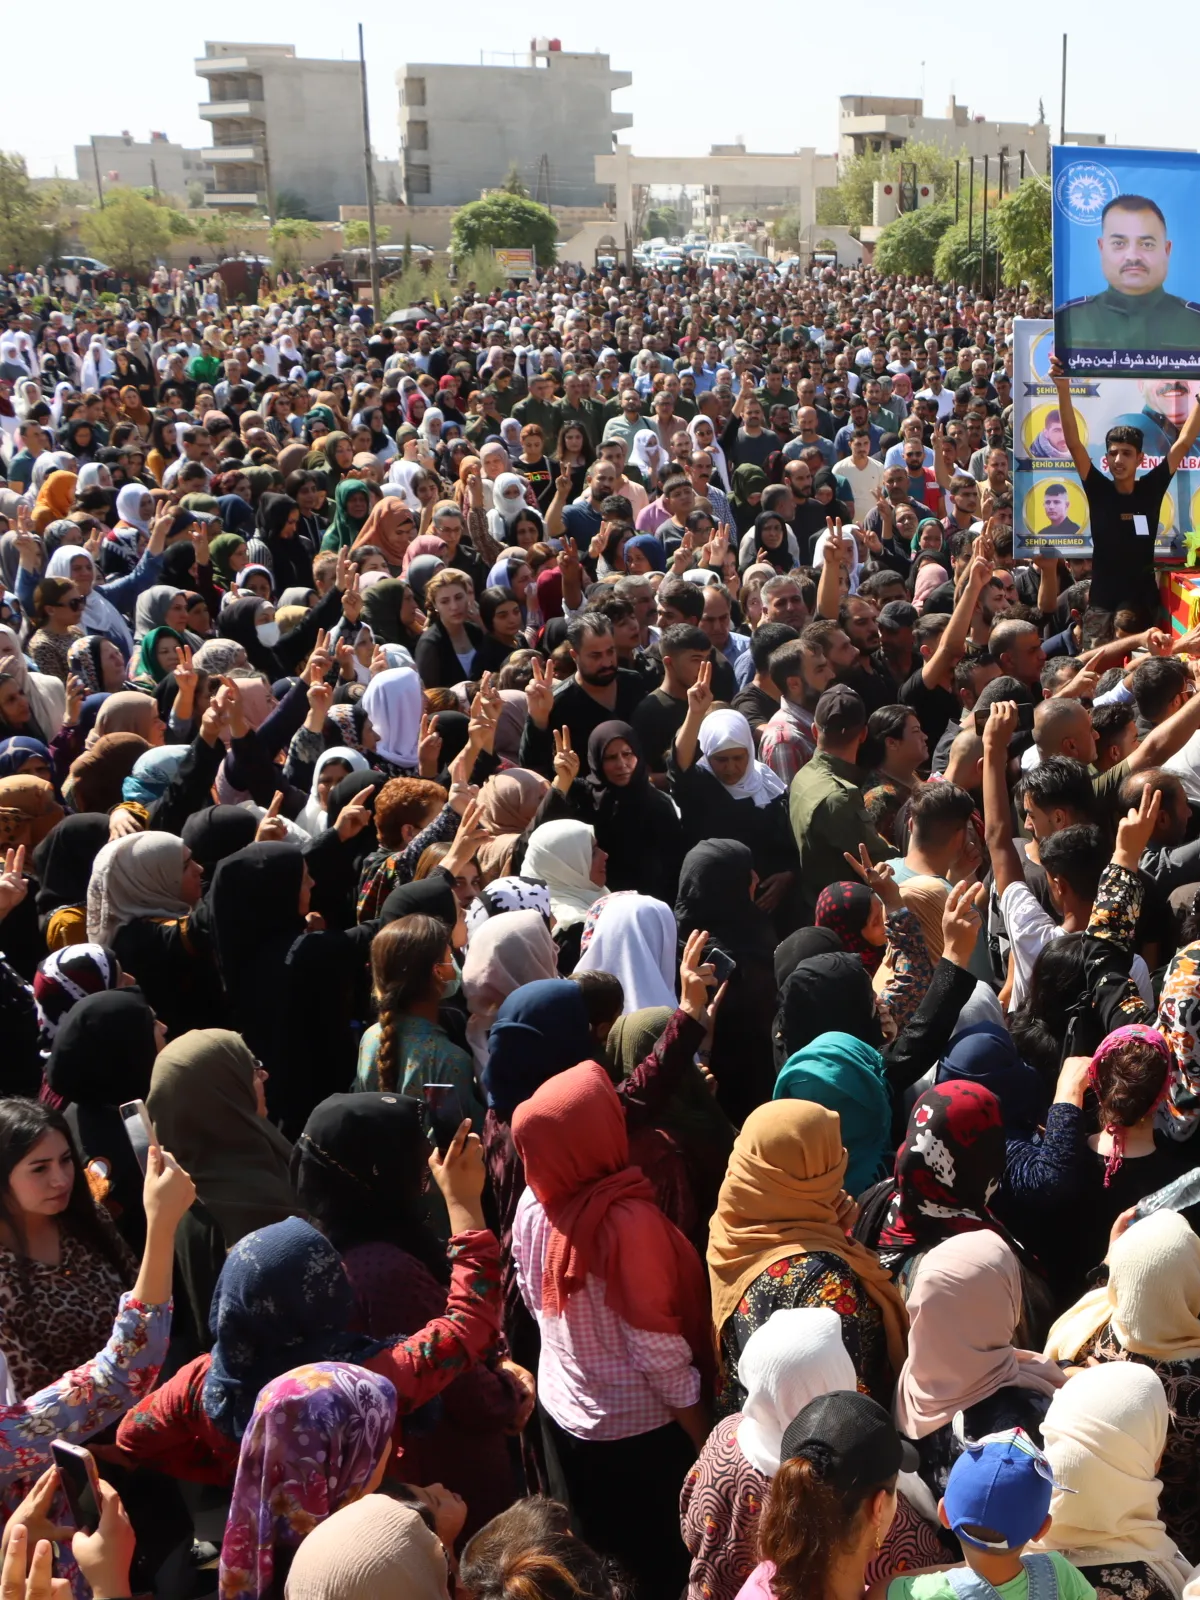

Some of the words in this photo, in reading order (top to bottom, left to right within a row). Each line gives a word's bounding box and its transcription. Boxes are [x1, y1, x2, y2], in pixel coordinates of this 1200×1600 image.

[1068, 354, 1092, 369] جولي
[1093, 350, 1116, 368] أيمن
[1145, 355, 1168, 369] الرائد
